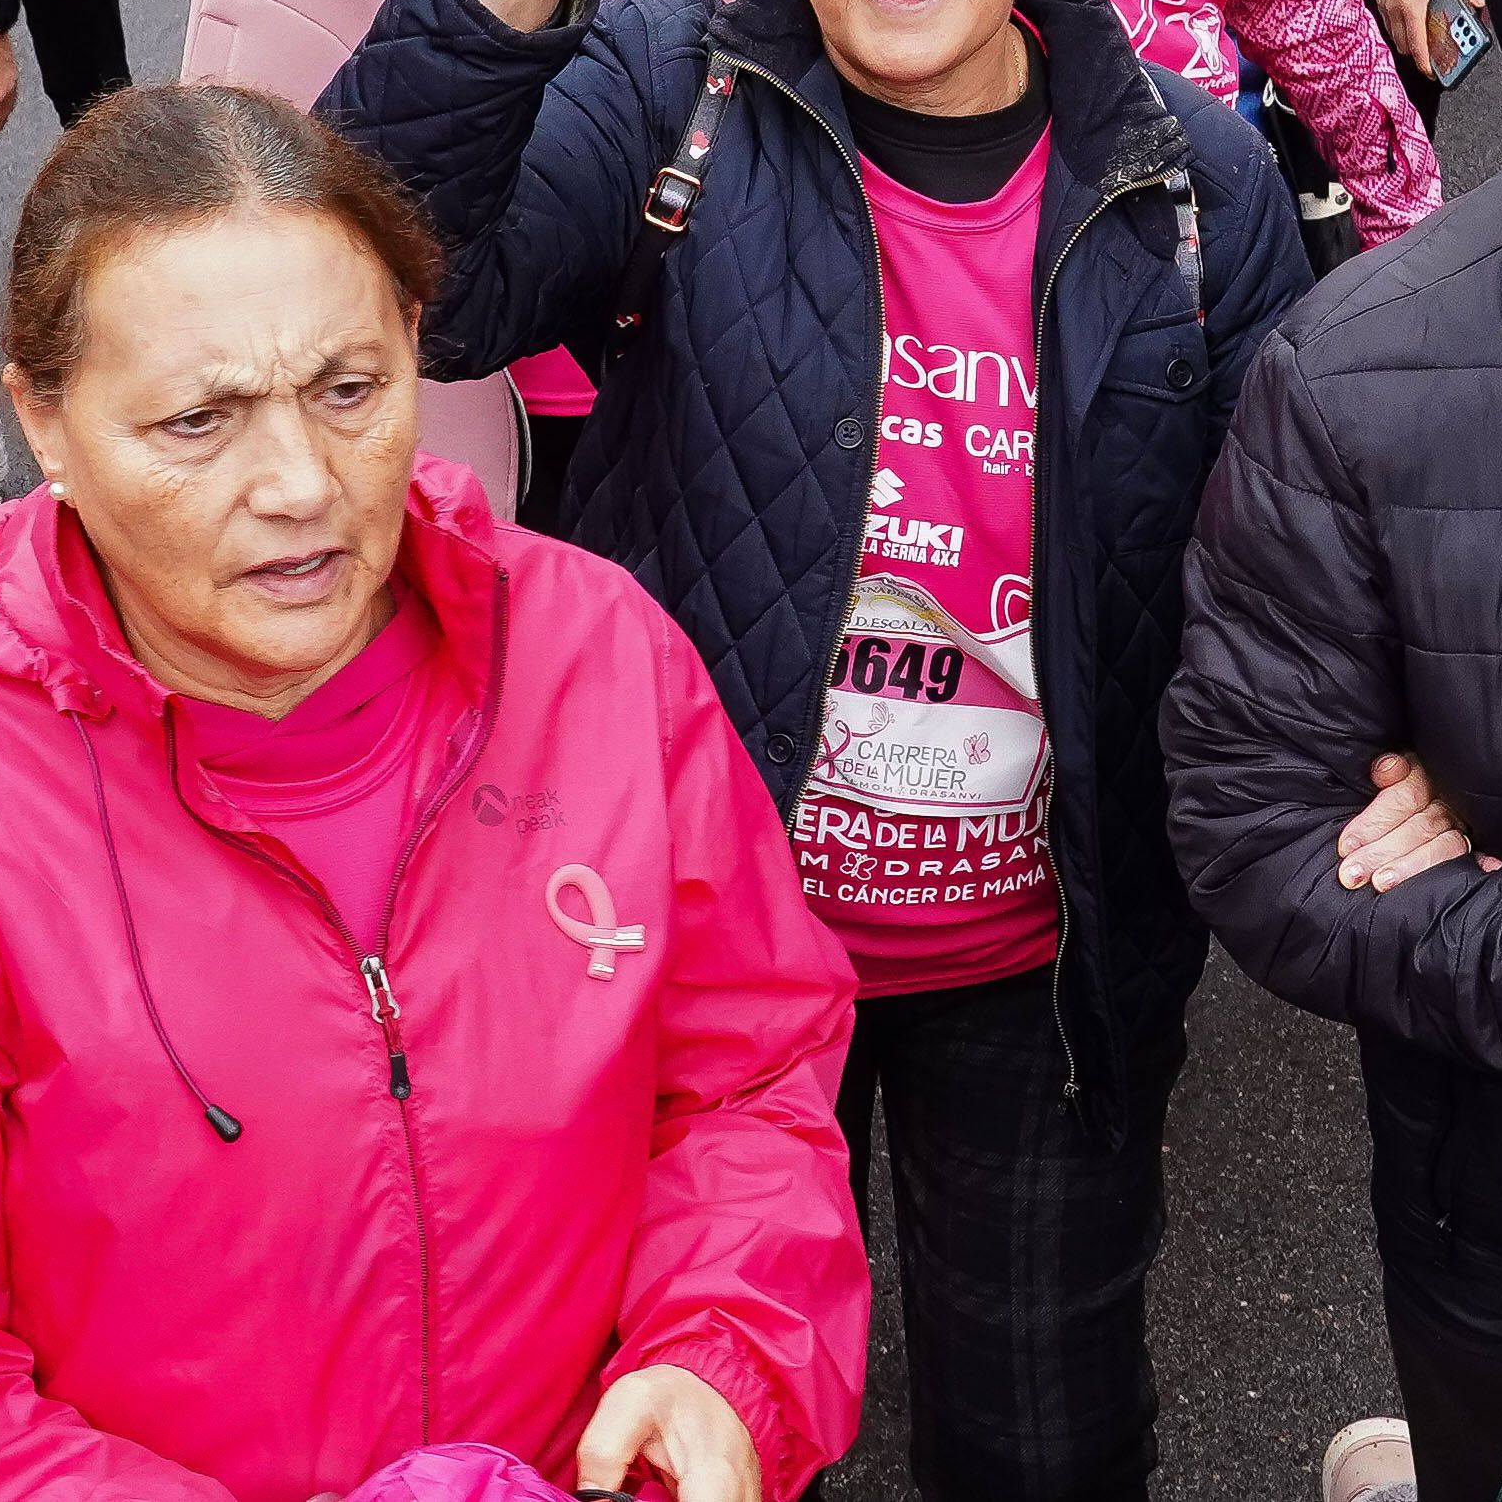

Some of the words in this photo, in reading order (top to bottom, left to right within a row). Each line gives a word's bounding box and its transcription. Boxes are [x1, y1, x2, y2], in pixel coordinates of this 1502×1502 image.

[982, 459, 1011, 476] hair
[881, 544, 928, 564] SERNA
[857, 740, 958, 769] CARRERA
[882, 763, 967, 791] MUJER
[874, 822, 919, 849] DE
[923, 824, 947, 849] LA
[802, 877, 831, 898] EL
[837, 883, 938, 906] CÁNCER
[943, 883, 978, 903] DE
[982, 863, 1046, 899] MAMA
